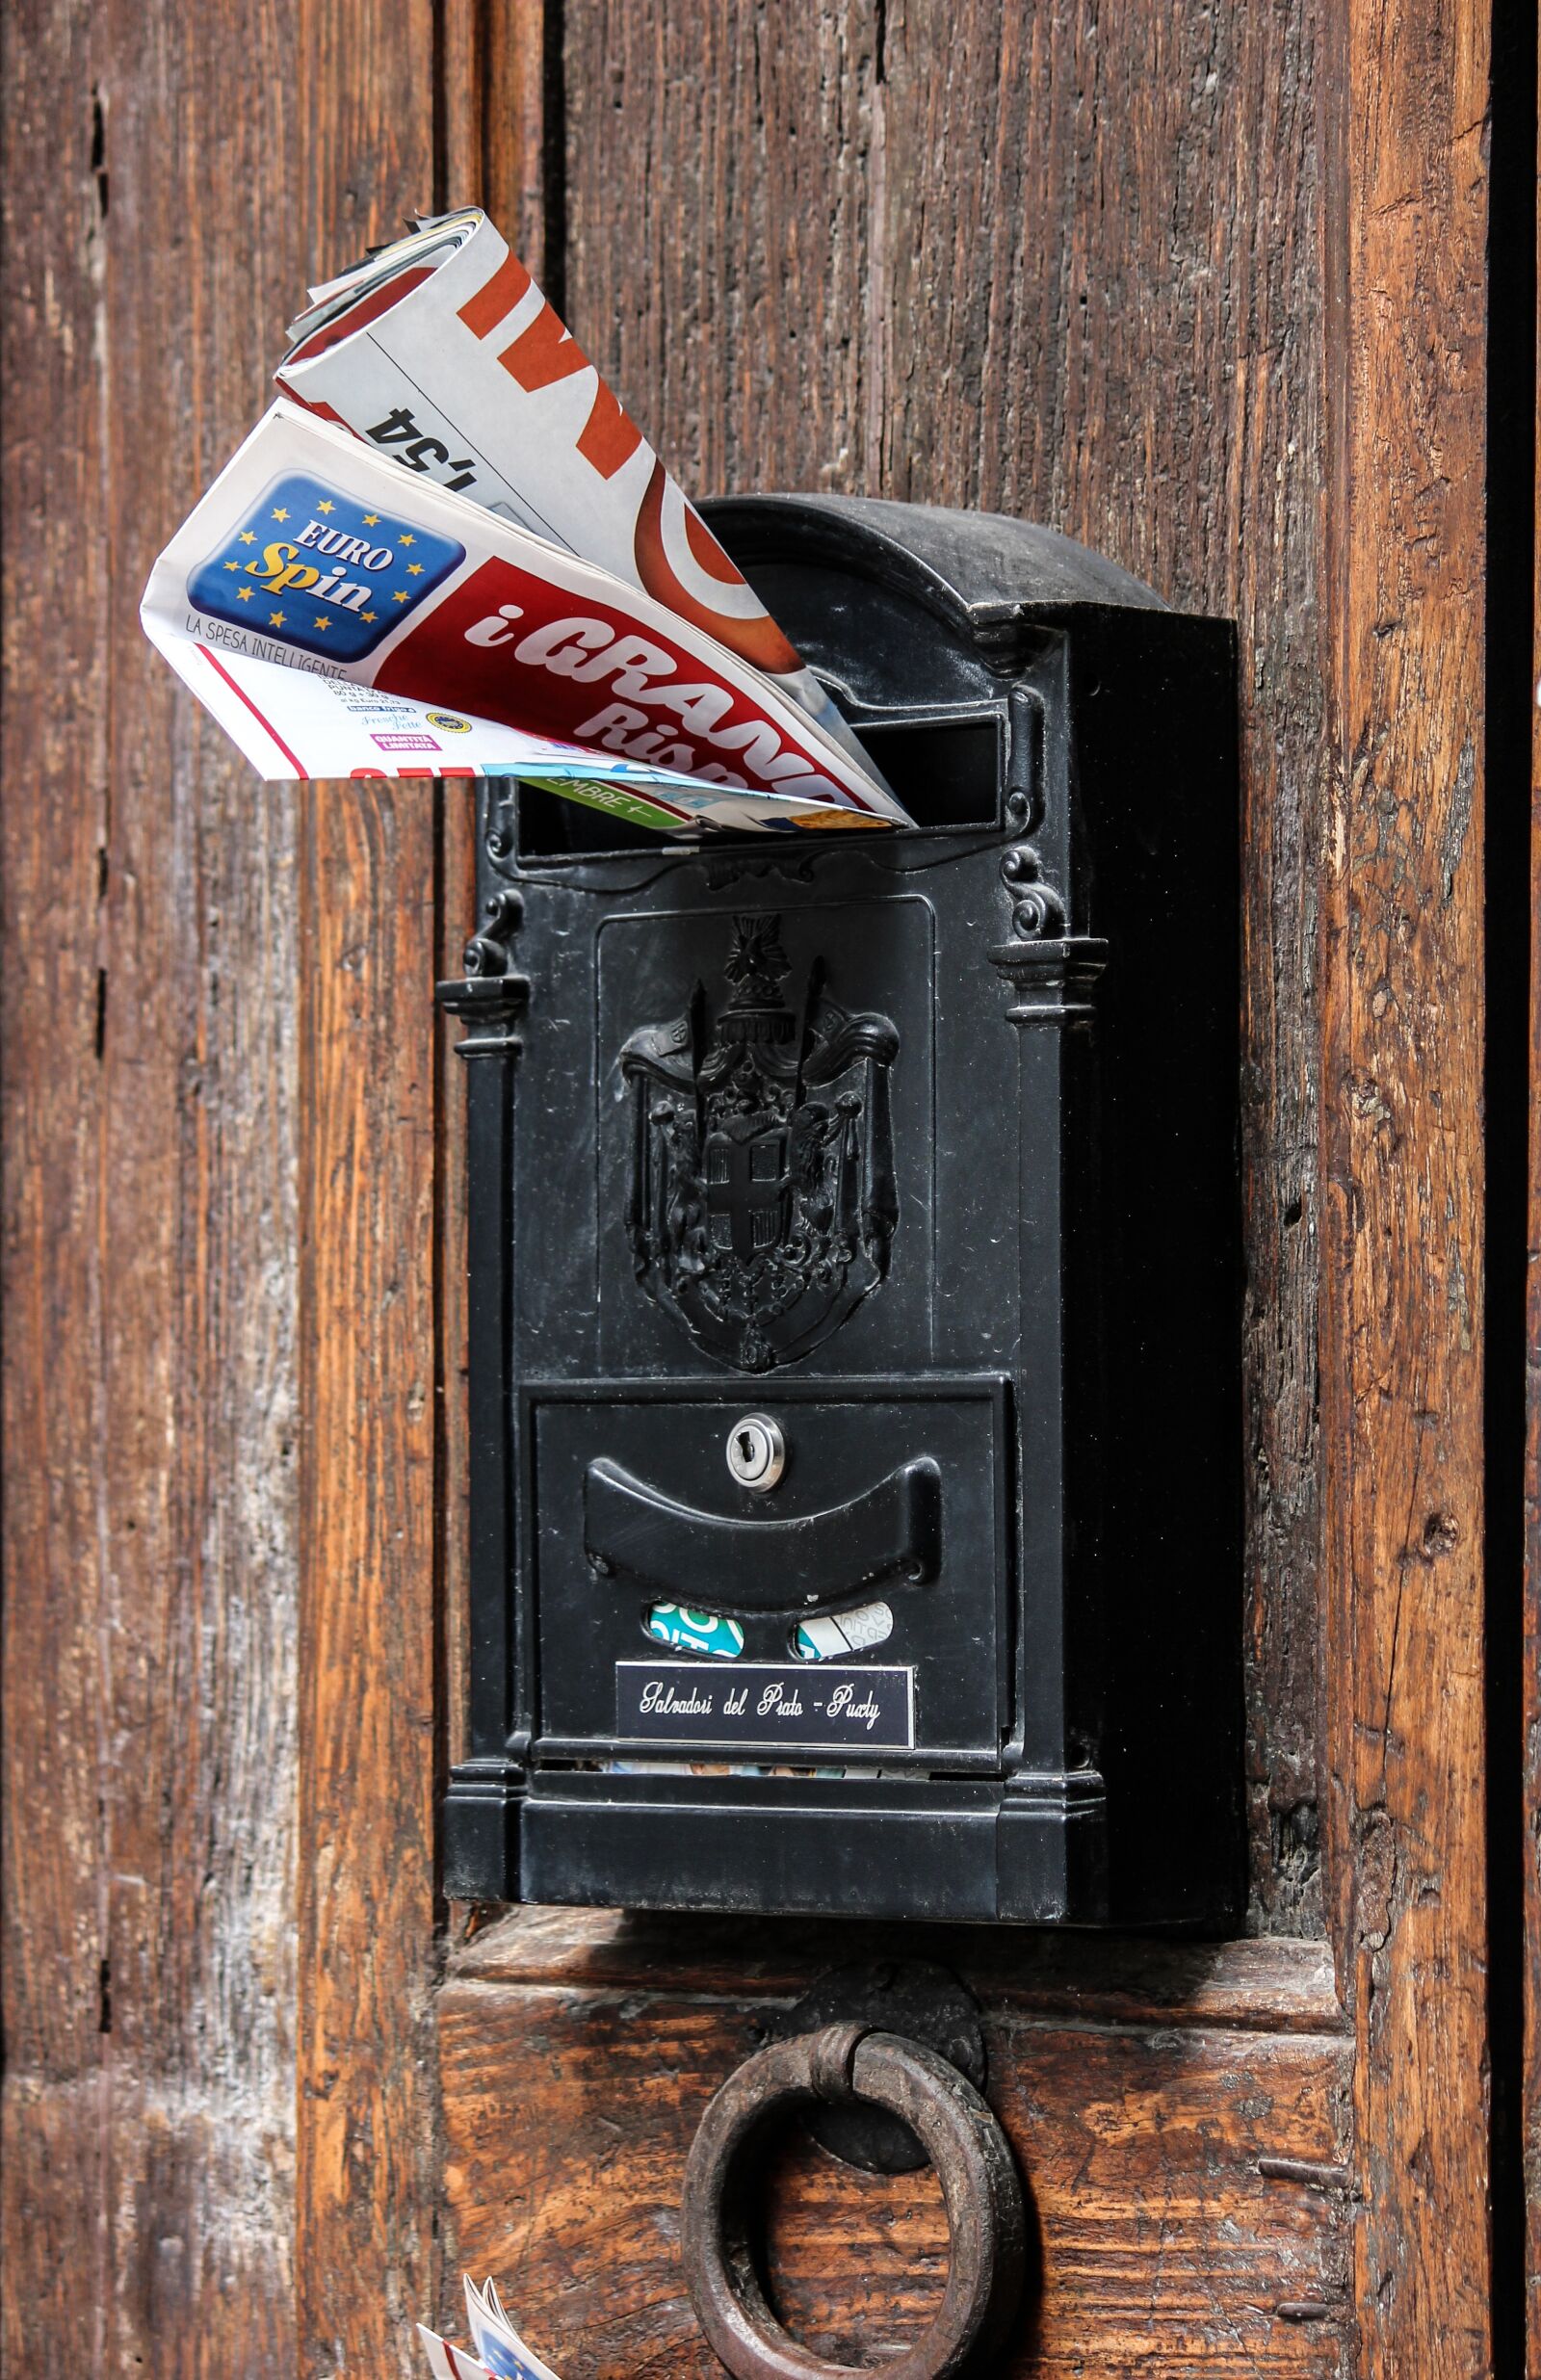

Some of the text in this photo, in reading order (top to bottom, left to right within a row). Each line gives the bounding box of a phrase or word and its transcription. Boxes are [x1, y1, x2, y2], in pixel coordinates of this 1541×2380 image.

[293, 519, 394, 571] EURO
[245, 542, 373, 613] Spin
[185, 614, 201, 635] LA
[205, 621, 248, 653] SPESA
[464, 604, 524, 646] i
[640, 1681, 713, 1714] Salvadori
[723, 1687, 748, 1716] del
[757, 1682, 804, 1716] Prato
